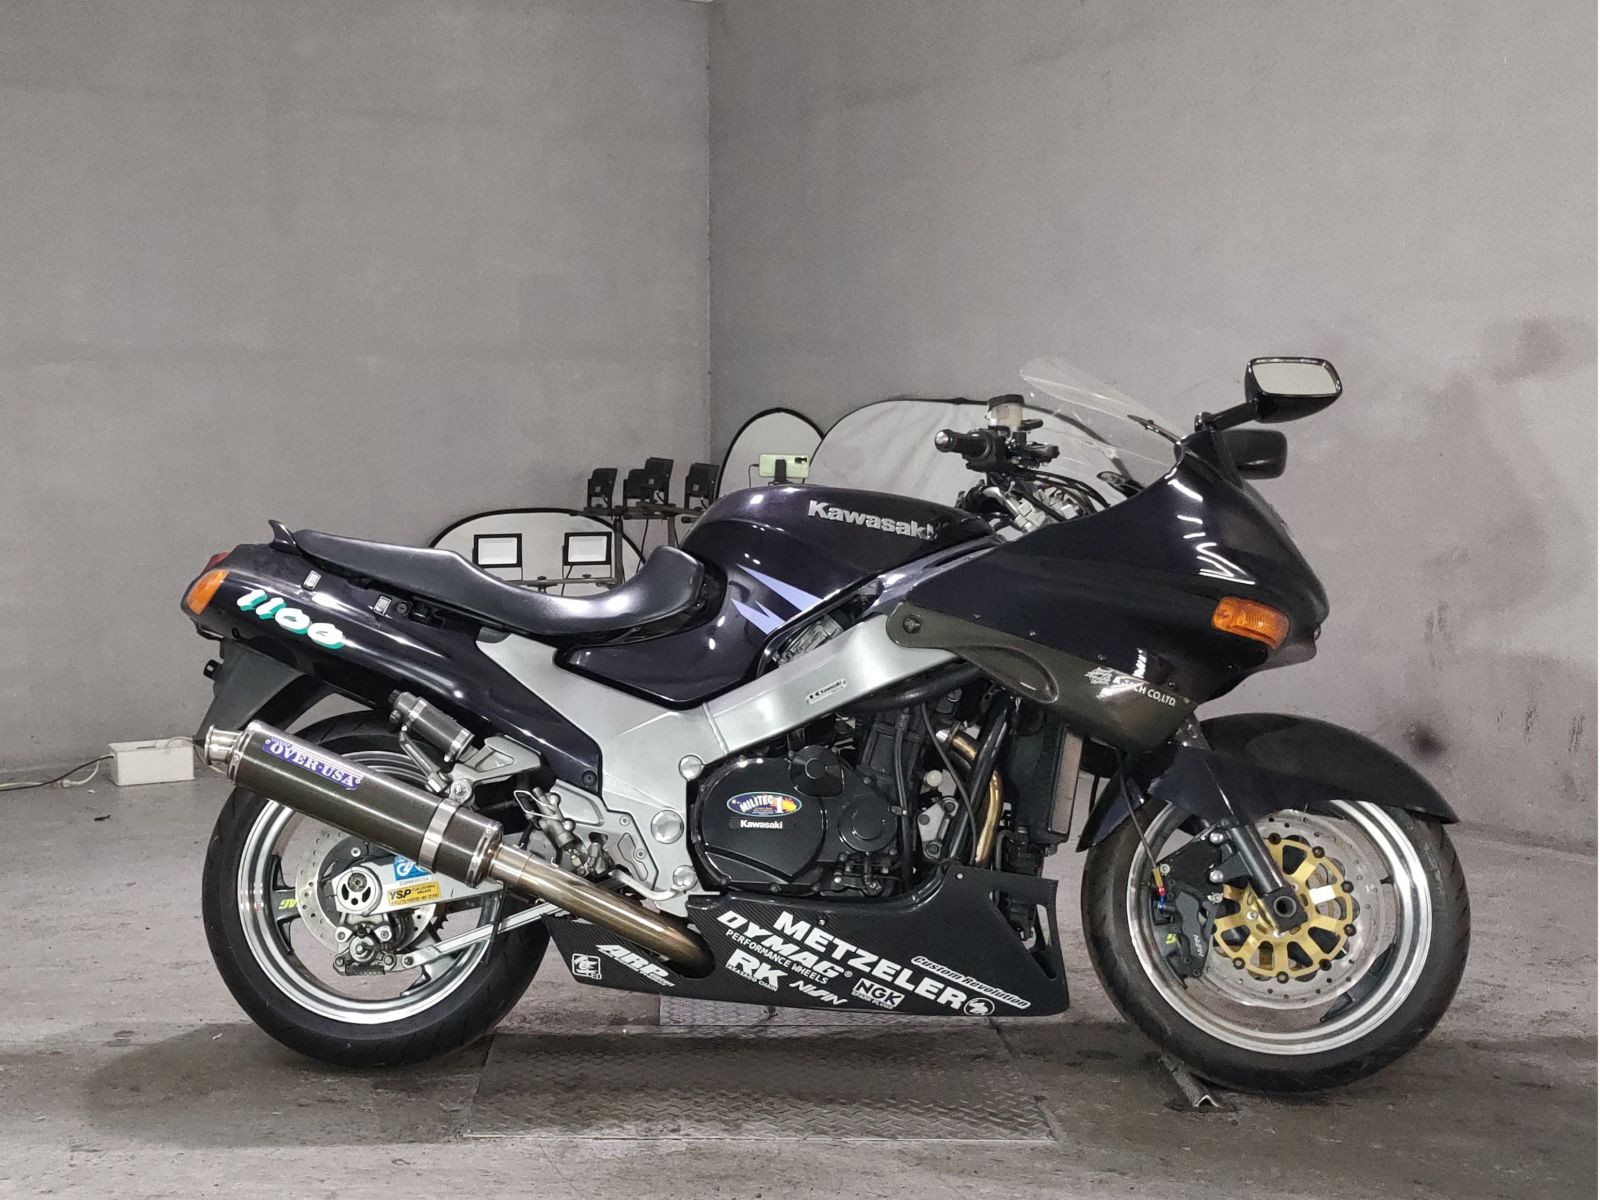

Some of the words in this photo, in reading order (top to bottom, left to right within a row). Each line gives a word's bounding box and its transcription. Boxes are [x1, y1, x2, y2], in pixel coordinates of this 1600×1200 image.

[237, 589, 345, 649] 1100
[740, 795, 774, 813] MILITEC
[740, 819, 783, 829] Kawasaki
[389, 888, 412, 900] YSP
[595, 944, 669, 978] ARP
[725, 929, 792, 967] PERFORMANCE
[791, 963, 829, 985] WHEELS
[726, 948, 788, 988] RK
[773, 911, 967, 1010] METZELER
[758, 980, 778, 992] CHAIN
[855, 979, 902, 1006] NGK
[914, 957, 963, 981] Custom
[962, 977, 1028, 1008] Revolution
